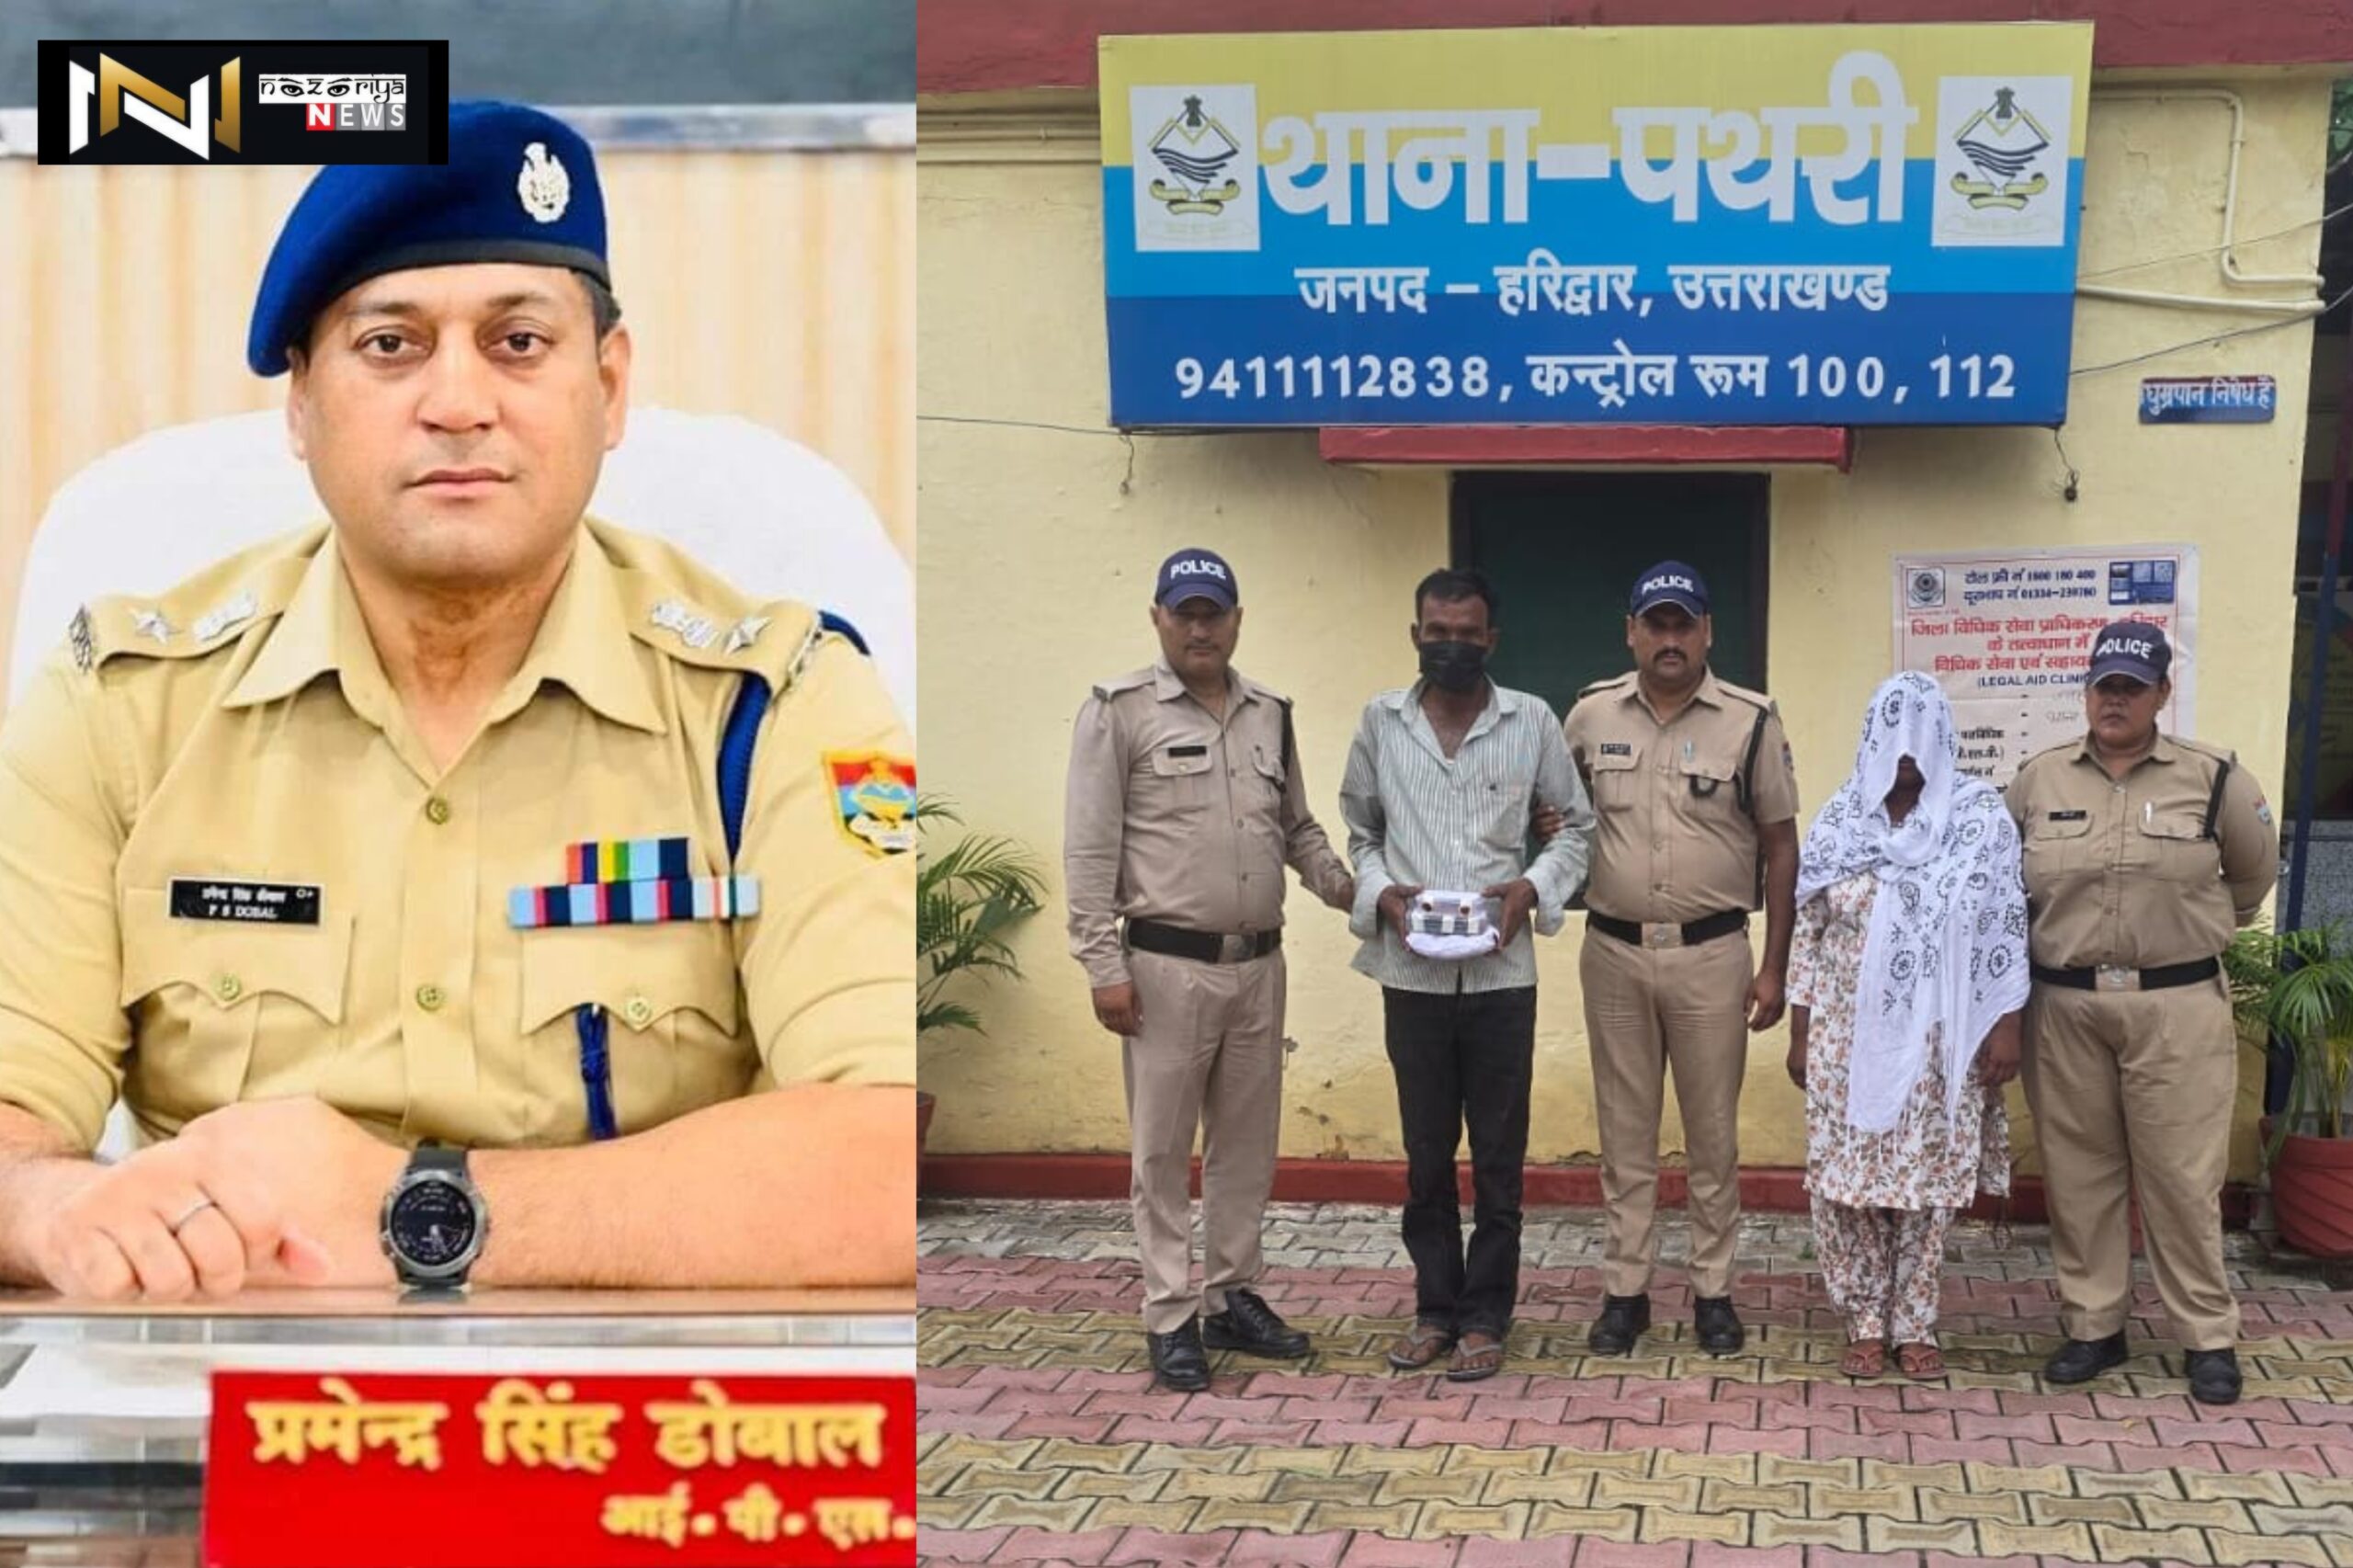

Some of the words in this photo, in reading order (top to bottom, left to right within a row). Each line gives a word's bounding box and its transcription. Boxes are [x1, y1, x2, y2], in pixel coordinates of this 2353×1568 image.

[1294, 267, 1429, 313] जनपद
[1494, 248, 1653, 317] हरिद्वार,
[1667, 265, 1892, 312] उत्तराखण्ड
[1525, 338, 1677, 407] कन्ट्रोल
[1688, 355, 1769, 397] रूम
[1930, 354, 2015, 398] 112
[1170, 559, 1226, 580] POLICE
[1641, 574, 1694, 596] POLICE
[2025, 674, 2048, 686] AID
[245, 1378, 449, 1471] प्रमेन्द्र
[475, 1378, 623, 1472] सिंह
